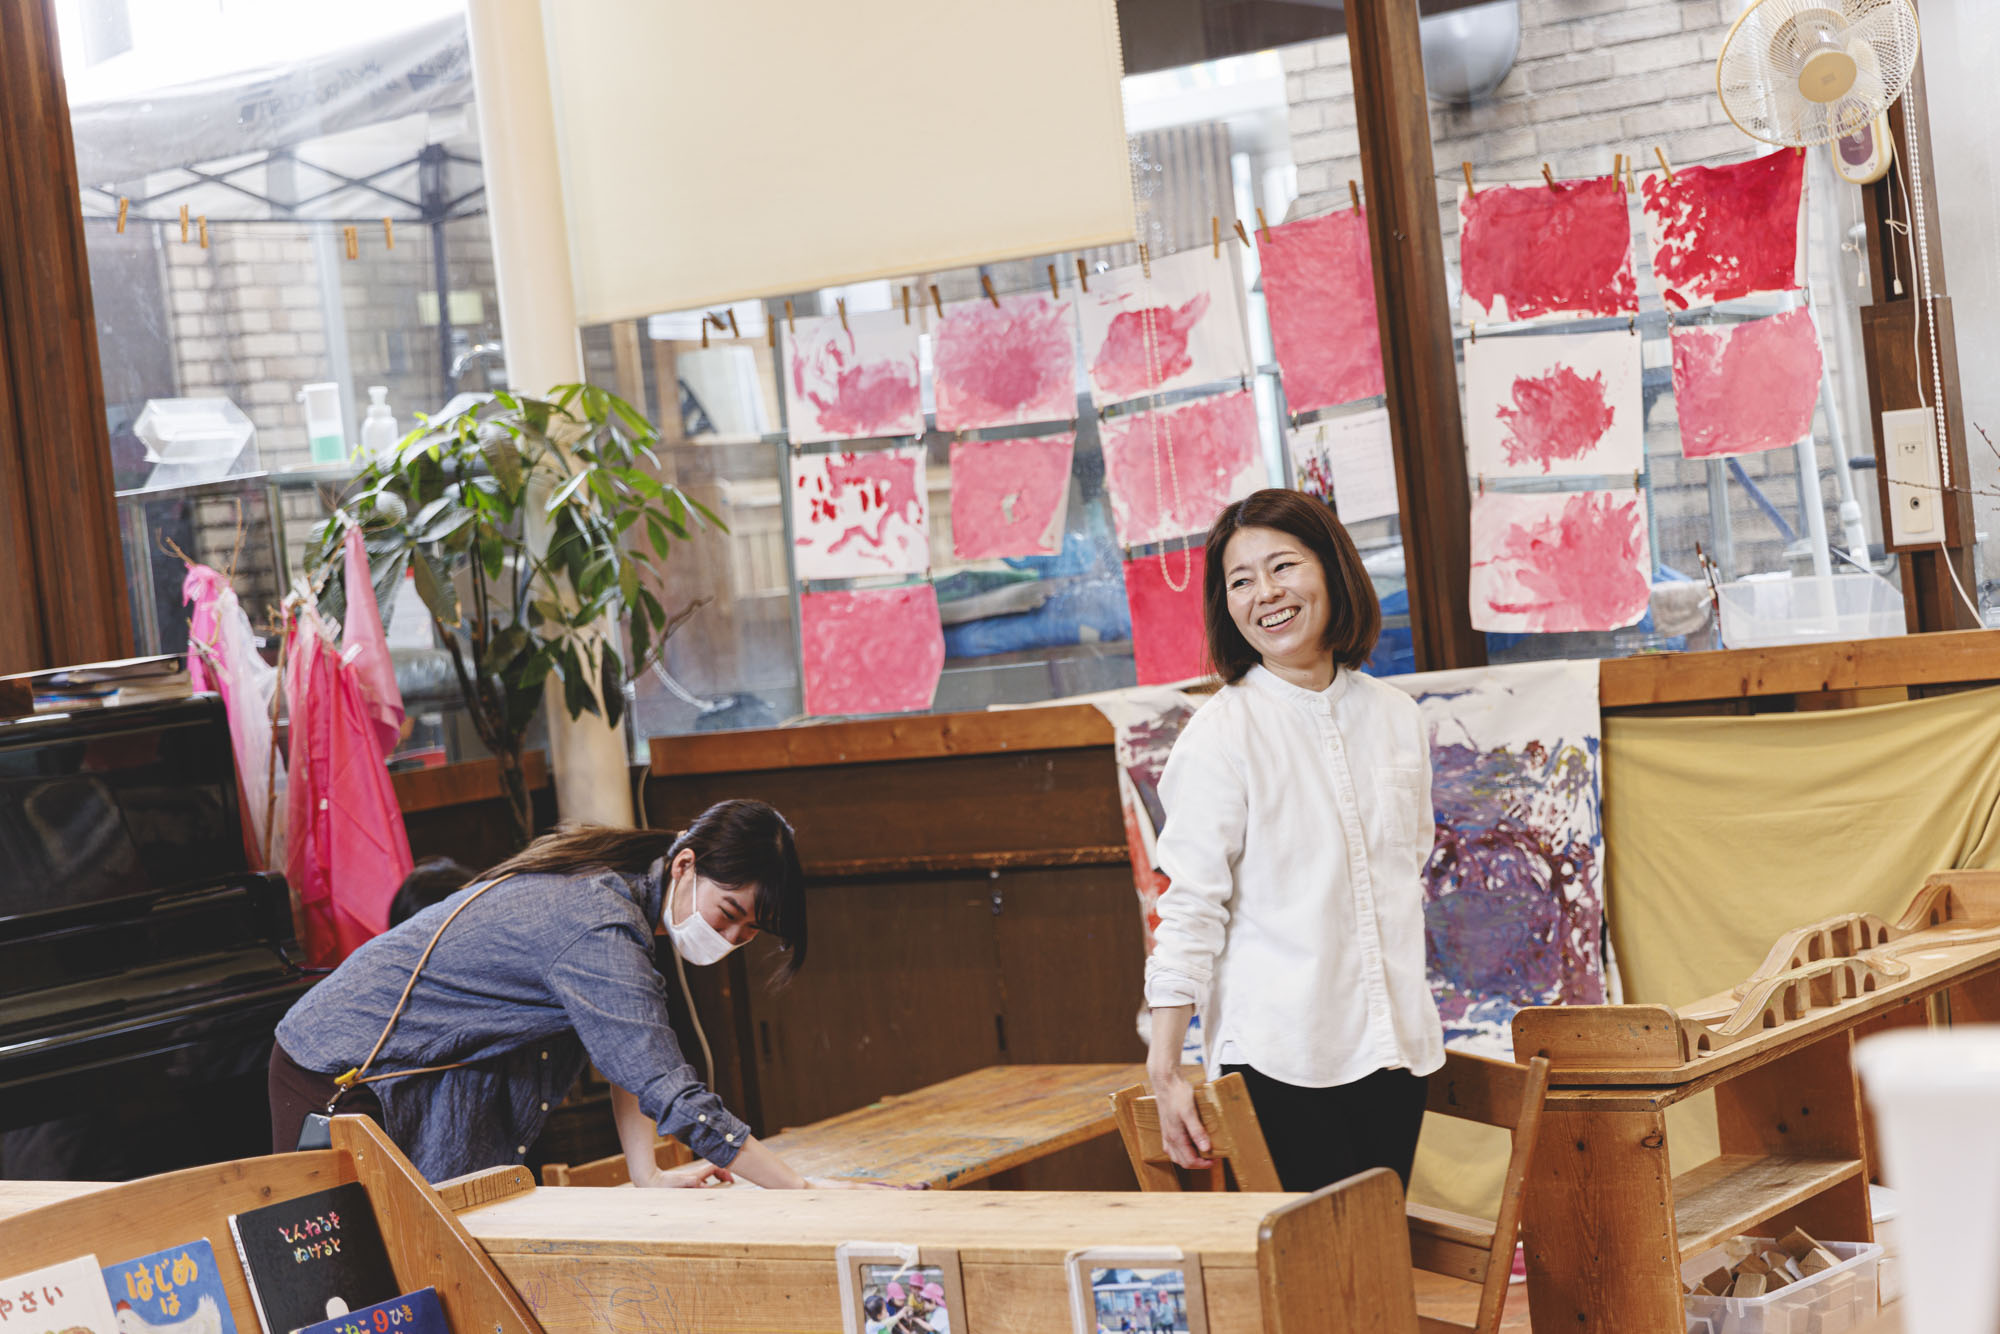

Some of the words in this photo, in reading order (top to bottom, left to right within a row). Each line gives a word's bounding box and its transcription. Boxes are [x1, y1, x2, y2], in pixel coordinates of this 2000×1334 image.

[278, 1211, 340, 1243] とんねるを
[293, 1237, 341, 1264] ぬけると
[125, 1252, 198, 1302] はじめ
[0, 1286, 64, 1321] やさい
[160, 1292, 181, 1316] は
